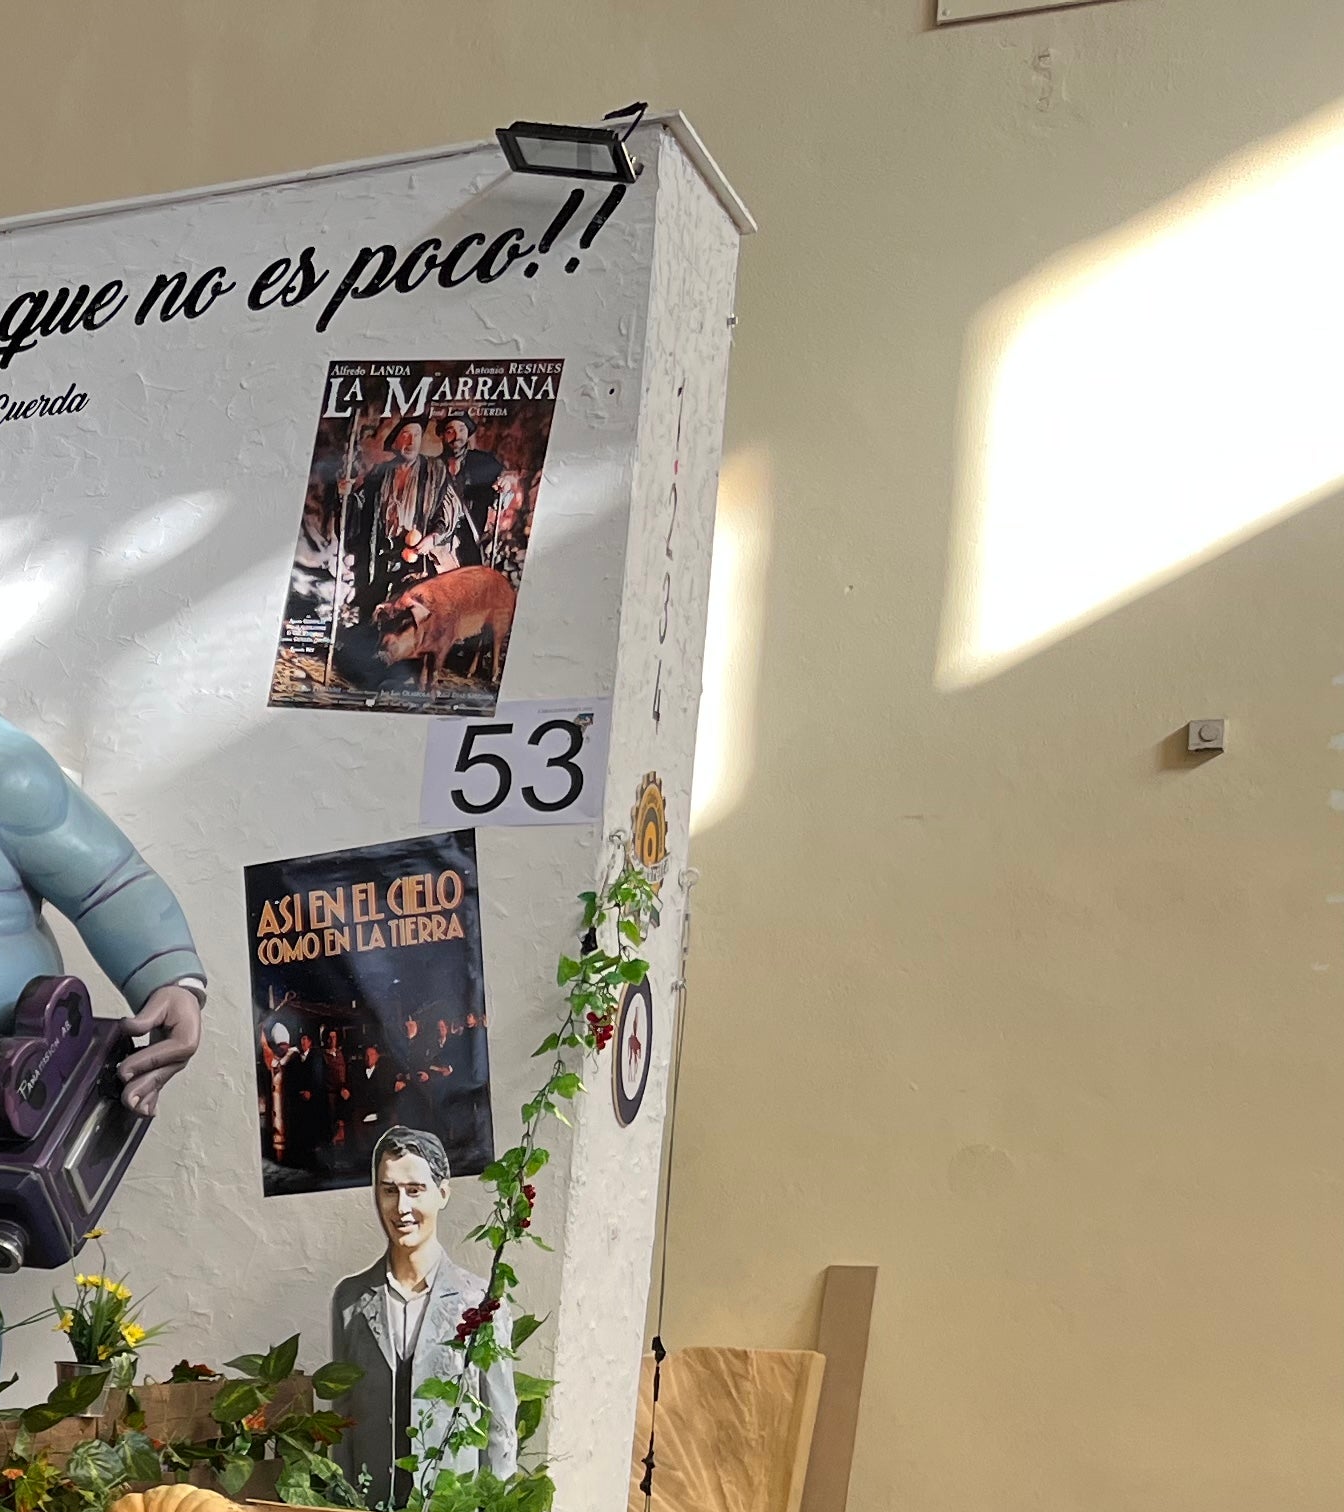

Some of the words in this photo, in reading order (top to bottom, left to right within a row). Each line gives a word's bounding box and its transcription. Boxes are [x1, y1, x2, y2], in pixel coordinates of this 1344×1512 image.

[135, 270, 235, 325] no
[247, 247, 329, 312] es
[315, 184, 626, 333] poco!!
[330, 364, 365, 376] Alfredo
[370, 364, 411, 376] LANDA
[465, 362, 504, 375] Antonio
[508, 362, 562, 374] RESINES
[322, 376, 363, 419] LA
[380, 376, 556, 419] MARRANA
[467, 406, 508, 417] CUERDA
[450, 719, 584, 815] 53
[256, 892, 303, 938] ASI
[308, 886, 346, 930] EN
[351, 881, 385, 923] EL
[386, 869, 464, 916] CIELO
[257, 931, 321, 966] COMO
[324, 925, 350, 957] EN
[355, 923, 386, 952] LA
[387, 912, 464, 948] TIERRA
